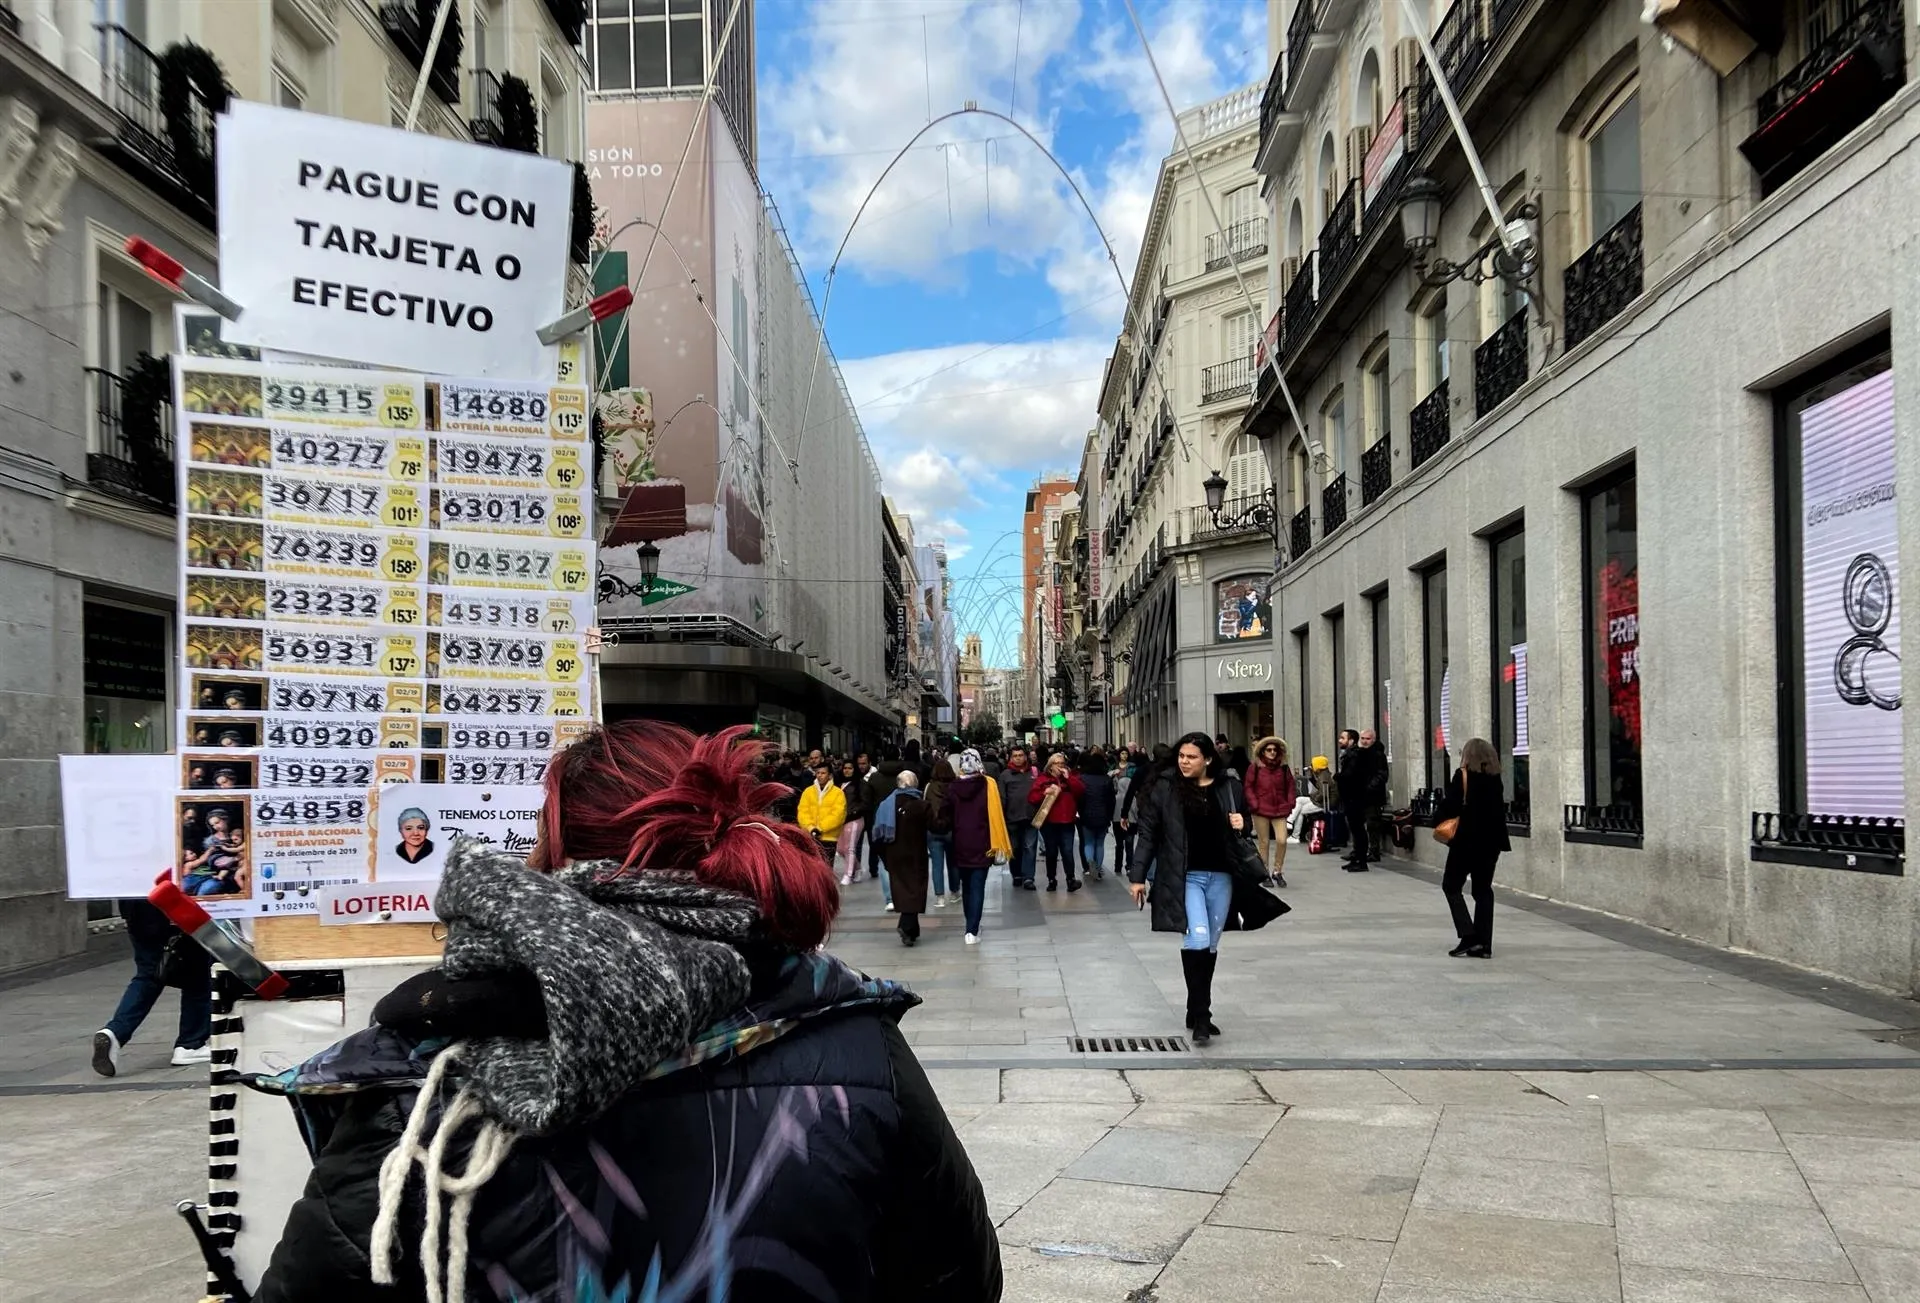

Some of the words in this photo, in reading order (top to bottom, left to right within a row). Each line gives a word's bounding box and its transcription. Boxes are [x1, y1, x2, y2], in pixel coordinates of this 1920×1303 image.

[589, 146, 632, 162] SIÓN
[610, 164, 662, 178] TODO
[298, 159, 440, 210] PAGUE
[454, 189, 536, 228] CON
[294, 219, 482, 276] TARJETA
[496, 253, 522, 282] O
[293, 277, 494, 332] EFECTIVO
[267, 384, 372, 409] 29415
[449, 393, 546, 418] 14680
[276, 438, 384, 464] 40277
[446, 450, 542, 473] 19472
[271, 483, 376, 509] 36717
[444, 498, 544, 520] 63016
[271, 535, 376, 562] 76239
[1091, 531, 1100, 568] Locker
[455, 551, 550, 574] 04527
[271, 590, 376, 614] 23232
[448, 604, 538, 624] 45318
[270, 637, 372, 661] 56931
[446, 641, 543, 663] 63769
[275, 688, 382, 710] 36714
[444, 694, 541, 713] 64257
[269, 726, 373, 746] 40920
[455, 730, 550, 748] 98019
[268, 764, 370, 784] 19922
[452, 763, 546, 780] 39717
[257, 800, 363, 820] 64858
[438, 810, 496, 820] TENEMOS
[257, 828, 304, 838] LOTERÍA
[308, 828, 362, 836] NACIONAL
[334, 895, 430, 916] LOTERIA
